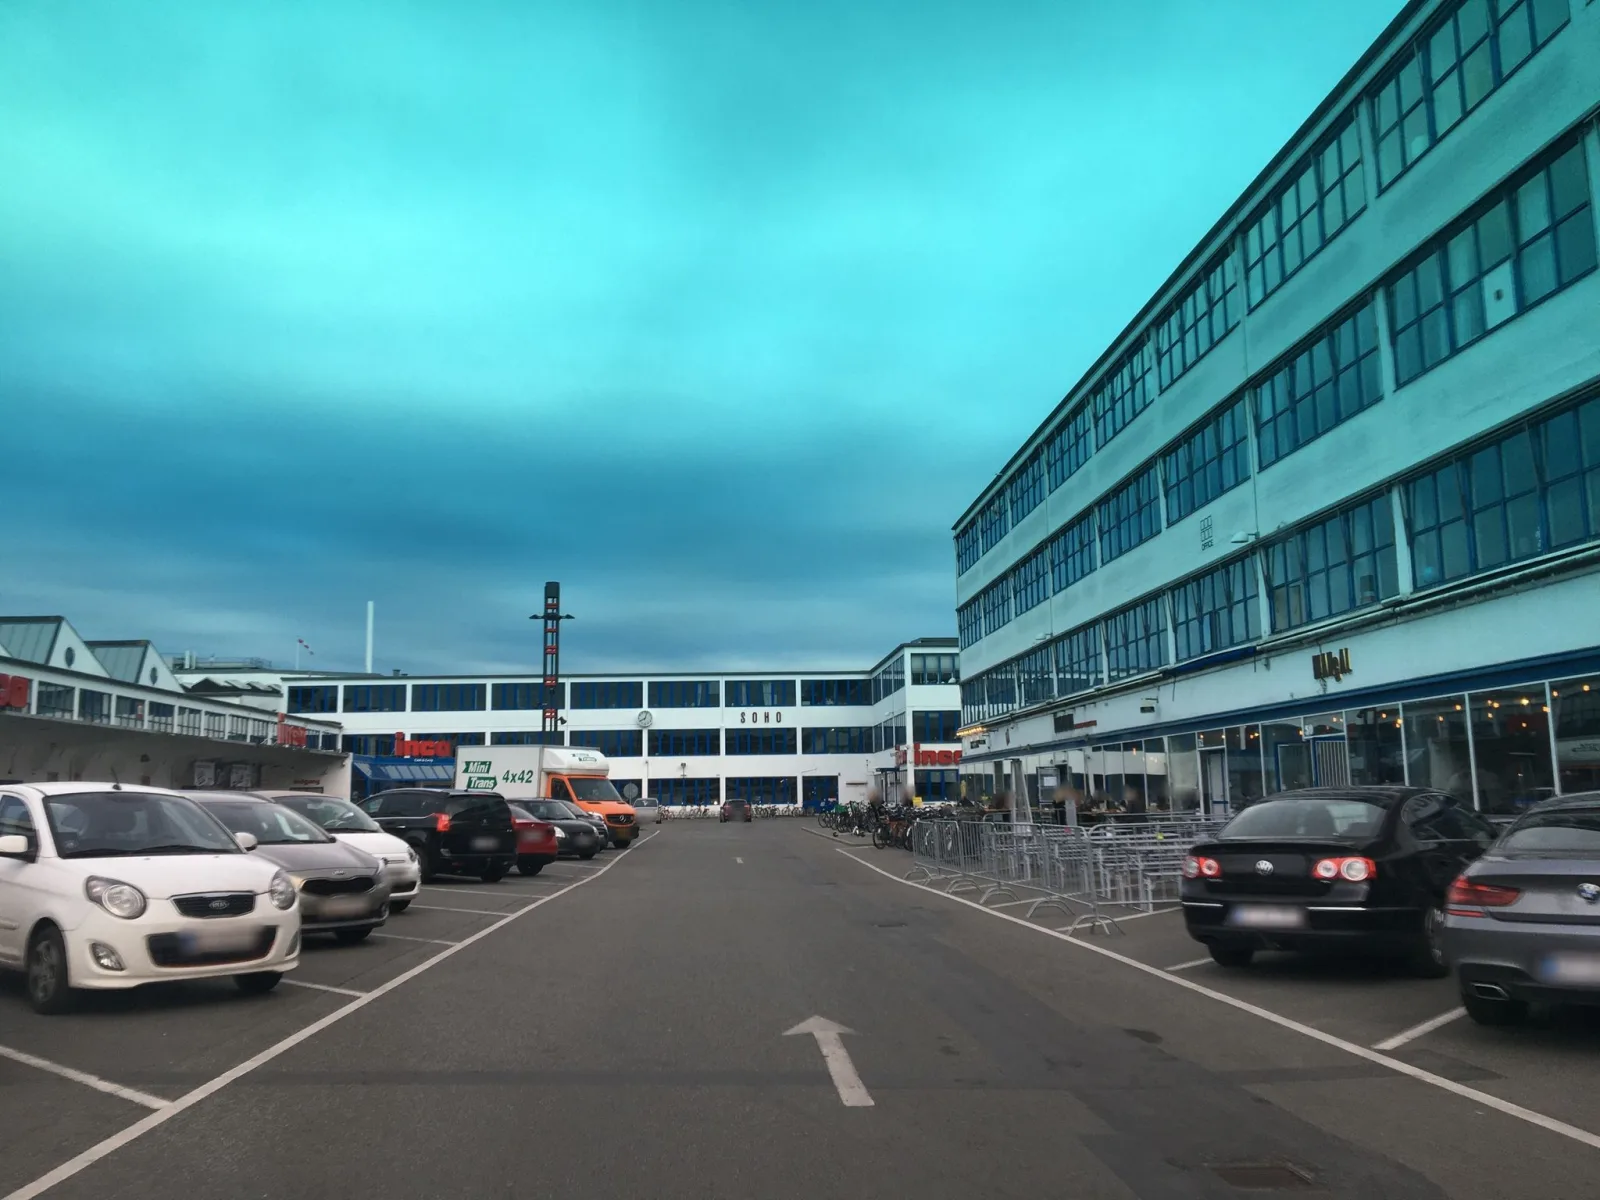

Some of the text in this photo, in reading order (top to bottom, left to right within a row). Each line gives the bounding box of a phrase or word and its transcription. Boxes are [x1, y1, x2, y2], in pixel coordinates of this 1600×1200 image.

[740, 711, 782, 724] SOHO
[395, 731, 452, 757] inco
[468, 762, 490, 773] Mini
[470, 777, 495, 789] Trans
[502, 769, 534, 784] 4x42
